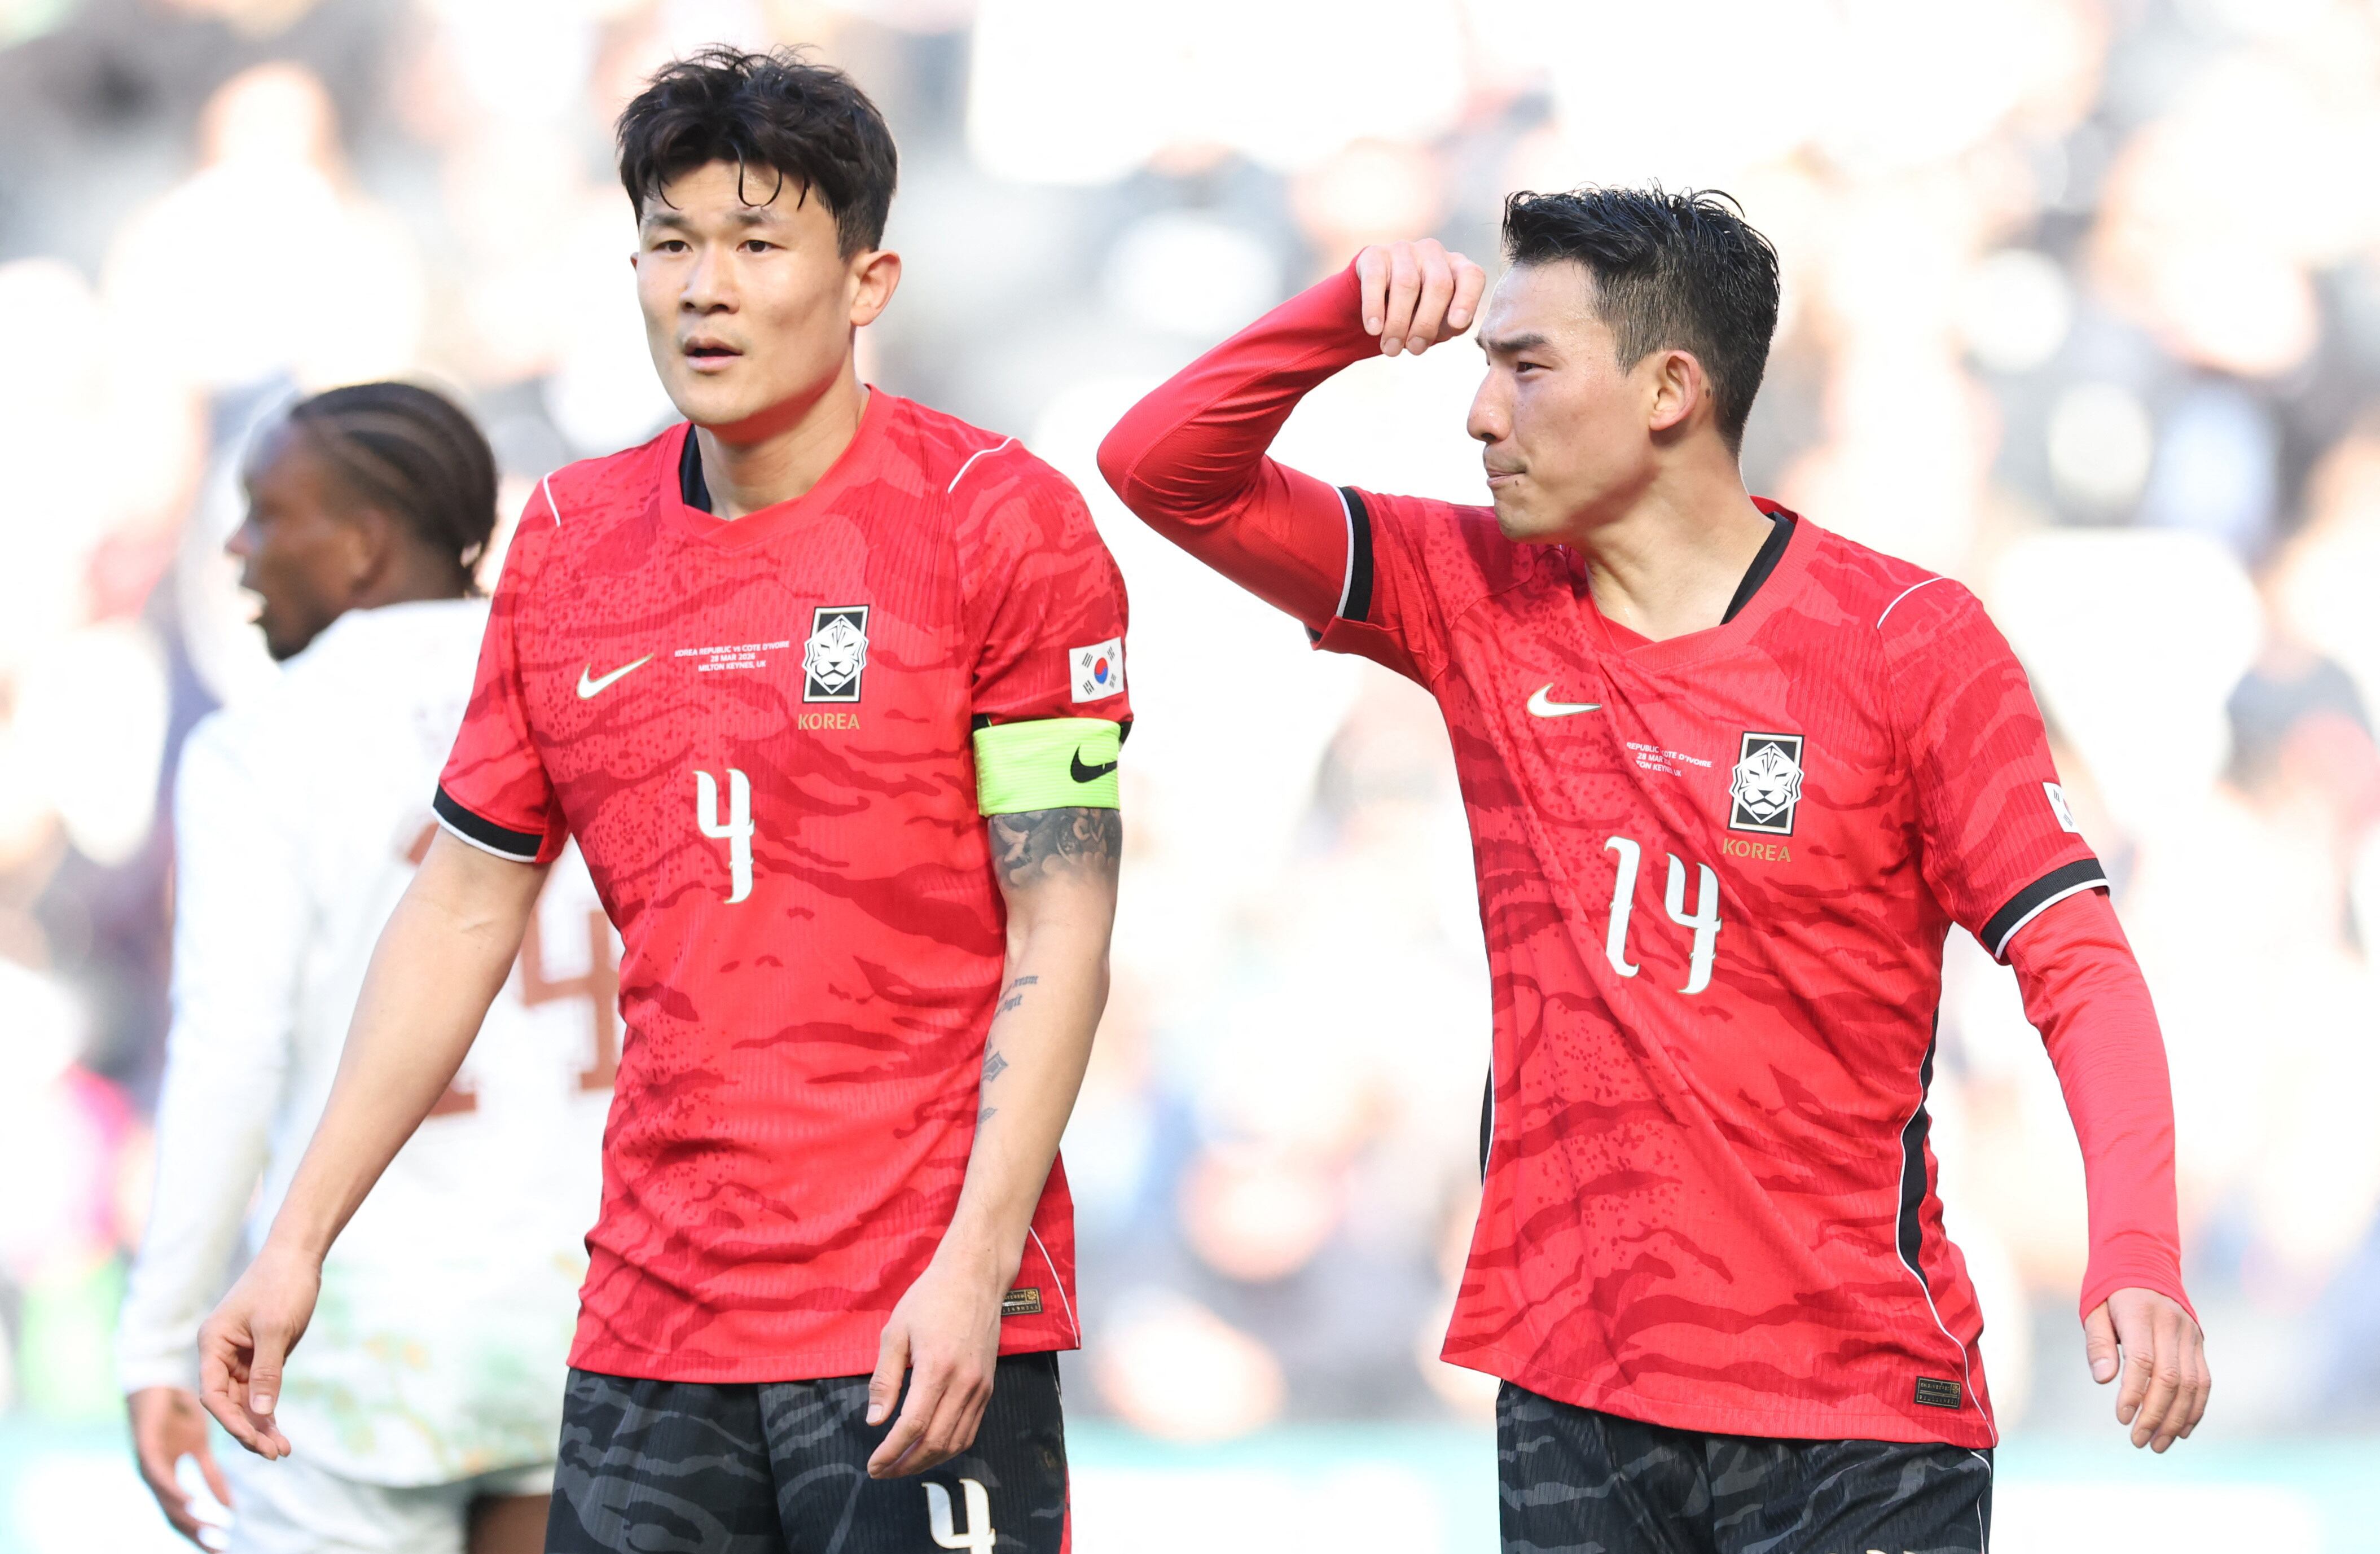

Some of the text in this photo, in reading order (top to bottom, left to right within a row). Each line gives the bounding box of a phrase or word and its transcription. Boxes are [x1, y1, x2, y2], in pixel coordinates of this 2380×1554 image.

[699, 646, 732, 655] REPUBLIC
[698, 663, 724, 672] MILTON
[798, 713, 860, 730] KOREA
[1626, 741, 1660, 753] REPUBLIC
[1679, 753, 1712, 768] D'IVOIRE
[1637, 752, 1646, 761] 28
[1648, 754, 1663, 763] MAR
[693, 768, 755, 904] 4
[1722, 838, 1791, 863] KOREA
[1604, 836, 1722, 994] 14
[921, 1478, 996, 1554] 4
